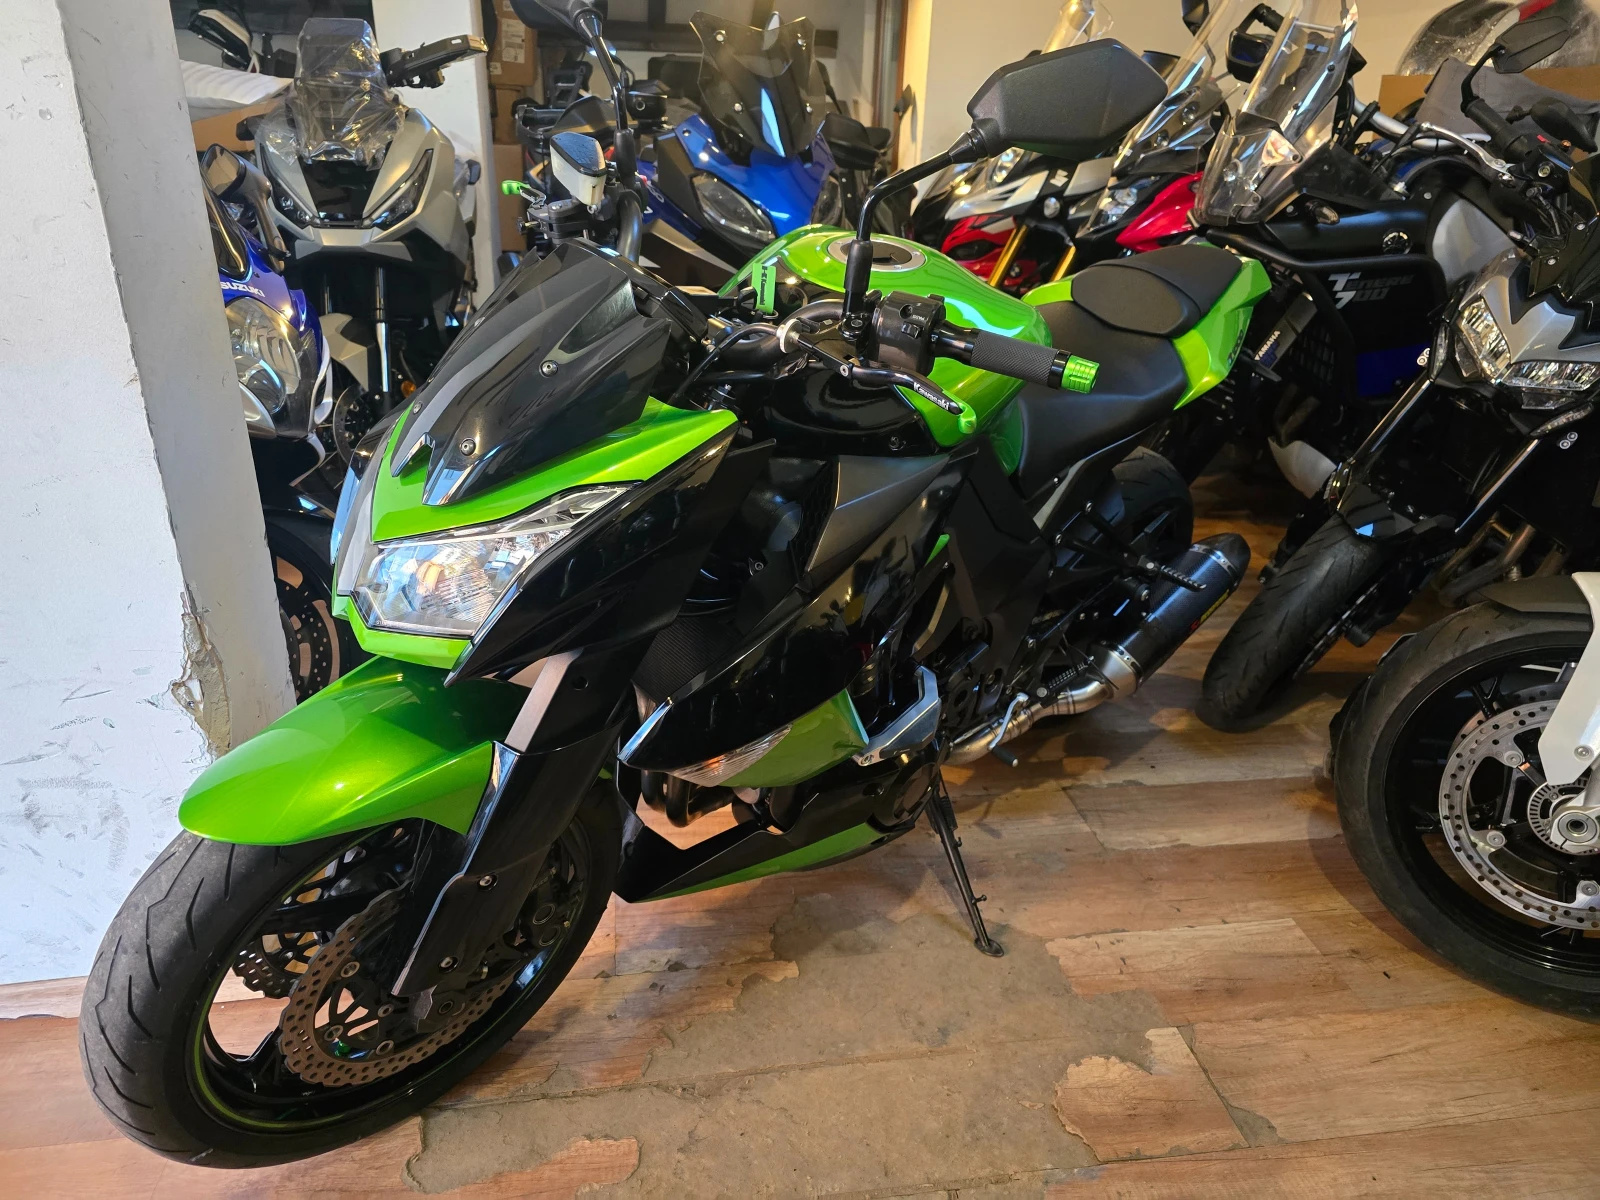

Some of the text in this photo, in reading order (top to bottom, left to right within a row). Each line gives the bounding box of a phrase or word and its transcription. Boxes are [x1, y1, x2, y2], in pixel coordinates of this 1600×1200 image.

[220, 281, 266, 298] SUZUKI
[1335, 288, 1390, 310] 700
[1254, 330, 1281, 361] YAMAHA
[913, 381, 949, 411] Kawasaki
